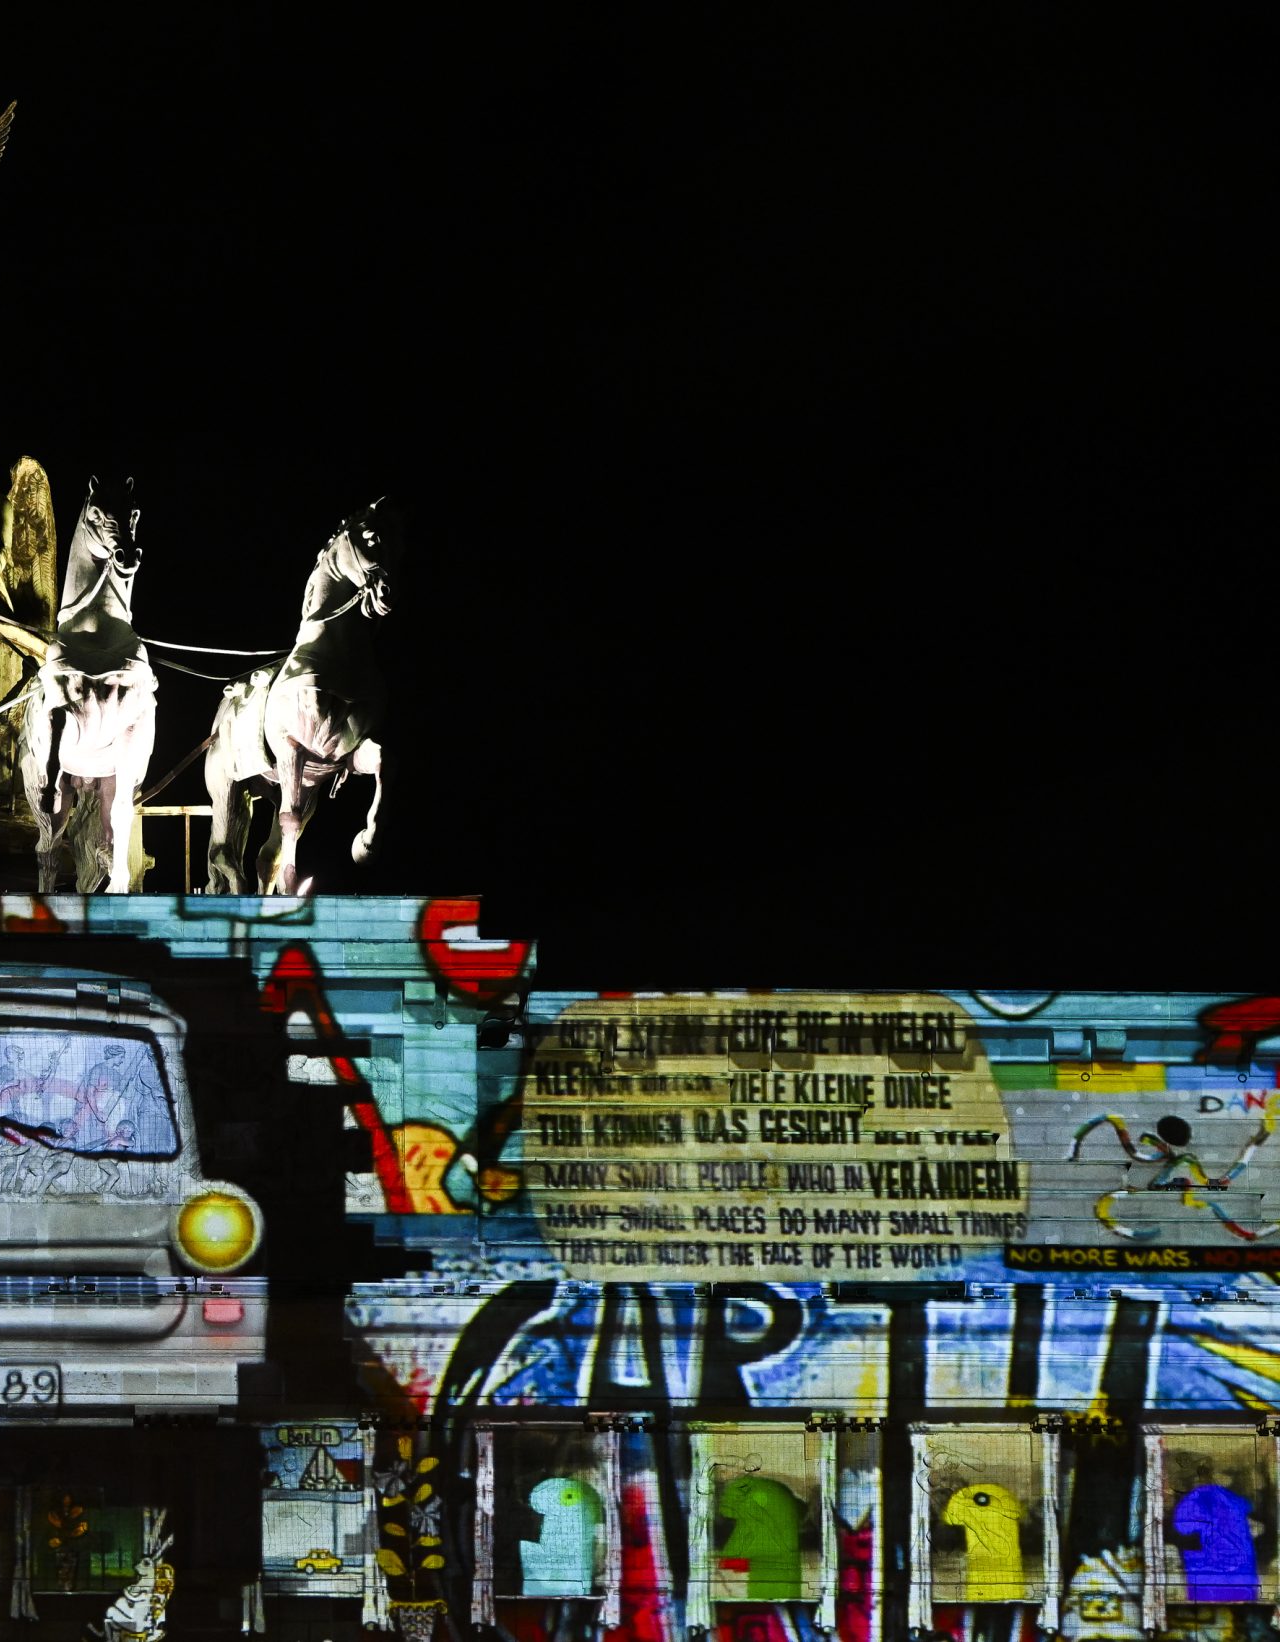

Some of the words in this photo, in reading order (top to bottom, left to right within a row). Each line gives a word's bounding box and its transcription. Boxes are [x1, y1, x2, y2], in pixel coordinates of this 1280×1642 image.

[839, 1011, 866, 1053] IN
[730, 1073, 786, 1104] VIELE
[793, 1073, 874, 1108] KLEINE
[884, 1075, 951, 1109] DINGE
[538, 1114, 583, 1147] TUN
[693, 1108, 748, 1144] DAS
[758, 1109, 861, 1144] GESICHT
[544, 1162, 608, 1189] MANY
[618, 1162, 690, 1191] SMALL
[697, 1162, 768, 1191] PEOPLE
[787, 1164, 835, 1192] WHO
[843, 1165, 864, 1190] IN
[867, 1157, 1019, 1200] VERÄNDERN
[545, 1204, 608, 1230] MANY
[620, 1205, 687, 1232] SMALL
[692, 1206, 767, 1234] PLACES
[778, 1207, 807, 1236] DO
[813, 1208, 881, 1235] MANY
[889, 1210, 954, 1236] SMALL
[955, 1211, 1028, 1239] THINGS
[718, 1243, 754, 1266] THE
[760, 1243, 803, 1266] FACE
[812, 1243, 835, 1269] OF
[842, 1243, 882, 1269] THE
[888, 1244, 962, 1270] WORLD
[1010, 1249, 1043, 1265] NO
[1049, 1249, 1118, 1266] MORE
[1124, 1249, 1198, 1267] WARS.
